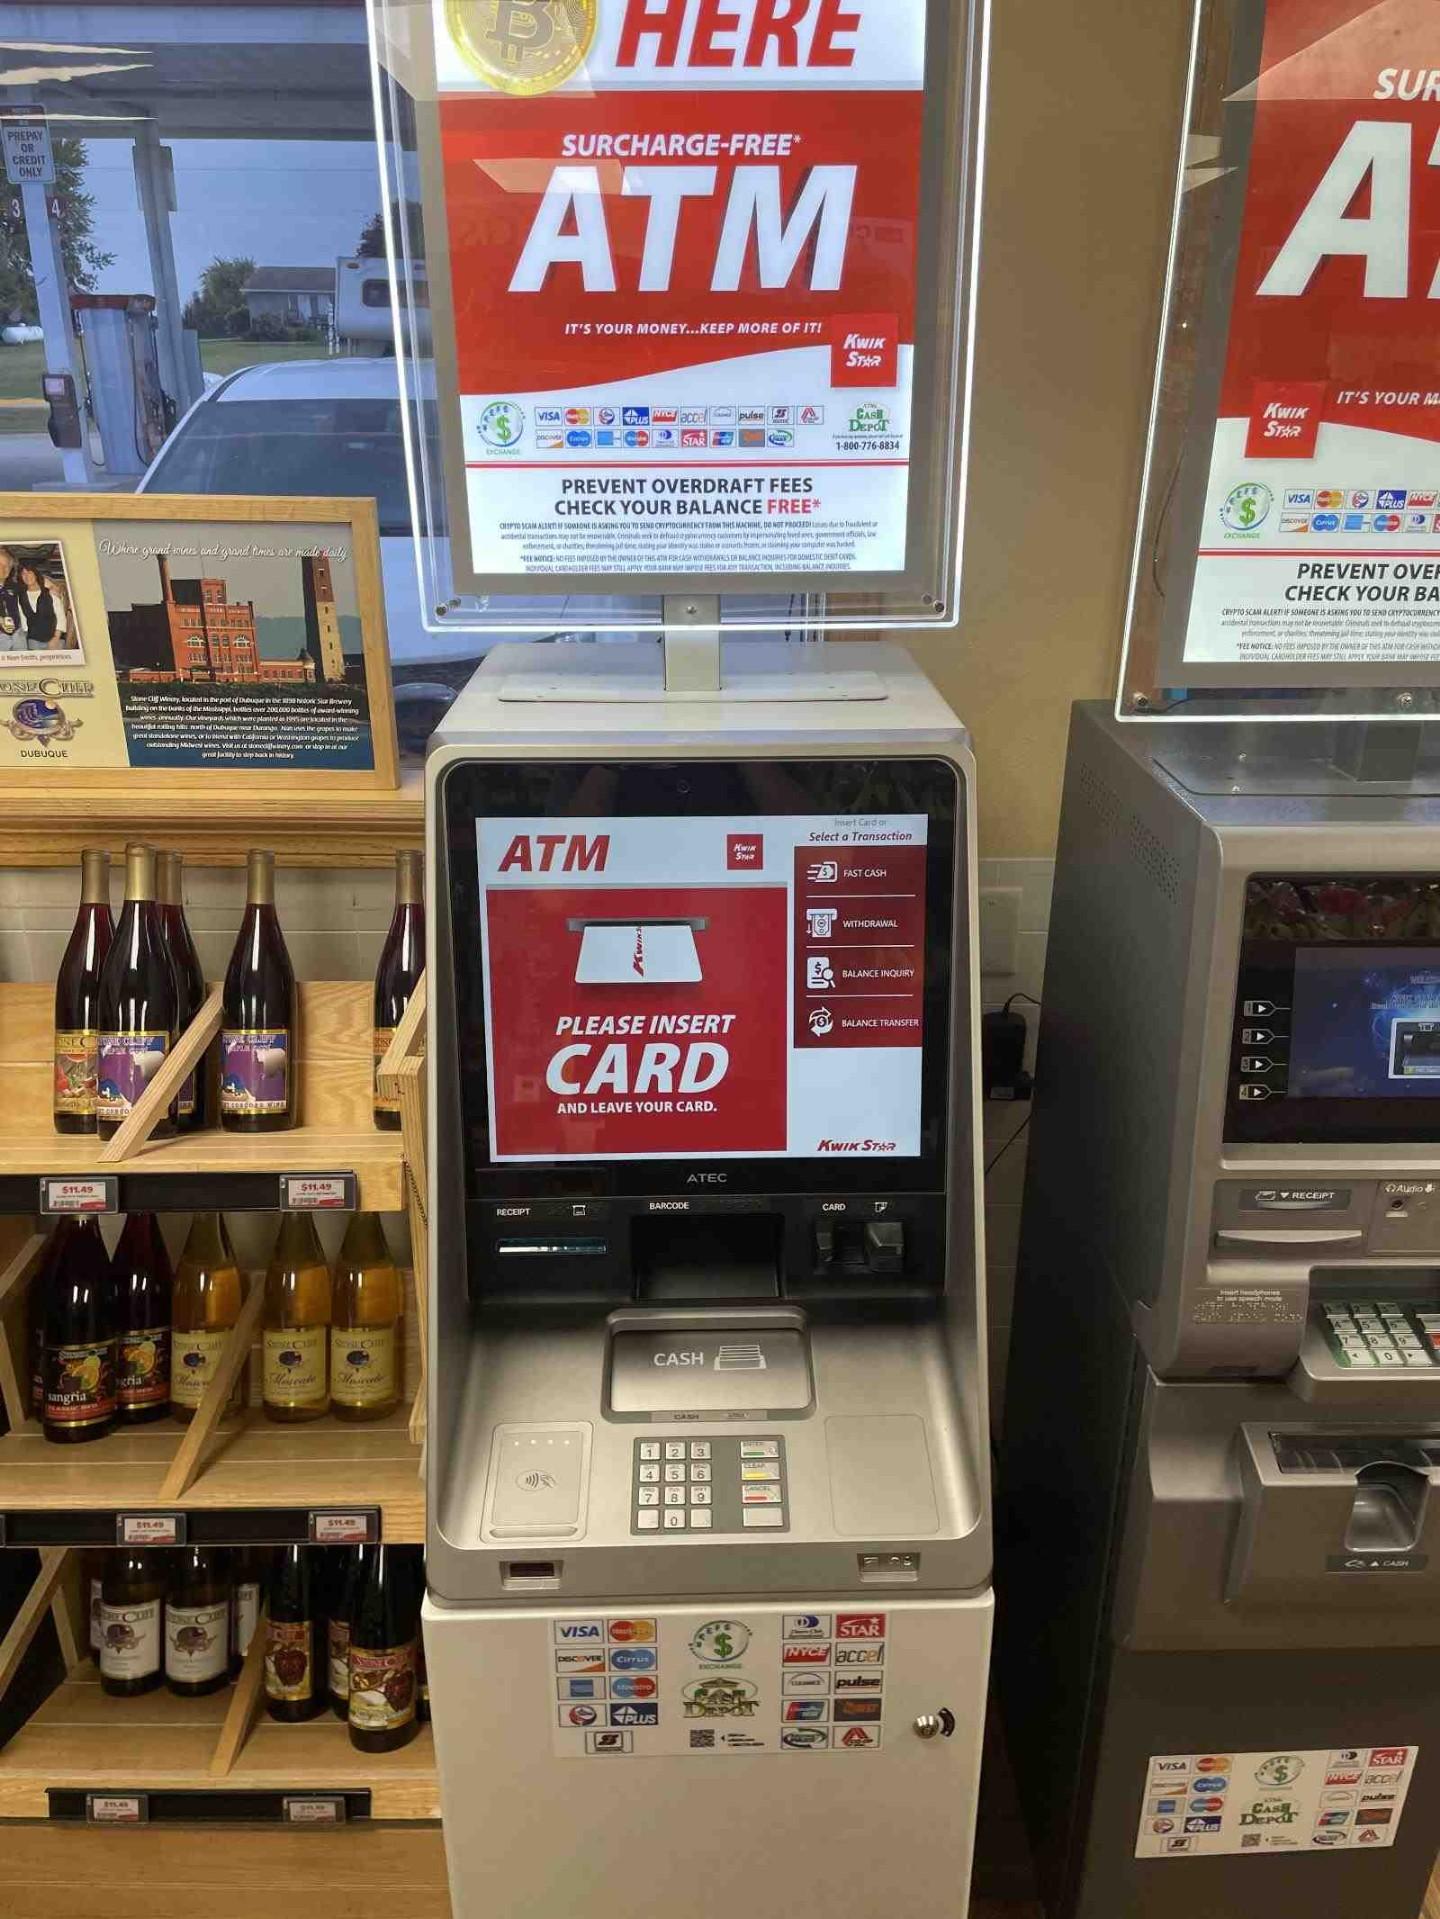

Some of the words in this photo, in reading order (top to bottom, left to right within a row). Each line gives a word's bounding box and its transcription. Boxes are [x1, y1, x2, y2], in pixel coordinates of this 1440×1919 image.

[616, 0, 862, 68] HERE
[7, 130, 43, 141] PREPAY
[21, 143, 34, 153] OR
[12, 155, 46, 166] CREDIT
[19, 167, 42, 178] ONLY
[11, 199, 20, 218] 3
[51, 198, 61, 219] 4
[507, 165, 858, 293] ATM
[595, 323, 635, 336] YOUR
[738, 322, 780, 335] MORE
[782, 322, 801, 335] OF
[803, 322, 822, 335] IT!
[1374, 391, 1424, 406] YOUR
[538, 410, 560, 421] VISA
[739, 411, 764, 421] pulse
[629, 417, 649, 426] PLUS
[683, 435, 706, 447] STAR
[836, 440, 900, 451] 1-800-776-8834
[561, 479, 647, 494] PREVENT
[651, 478, 766, 494] OVERDRAFT
[769, 477, 813, 493] FEES
[1287, 494, 1311, 504] VISA
[1383, 500, 1406, 509] PLUS
[554, 500, 615, 515] CHECK
[620, 500, 672, 515] YOUR
[676, 499, 763, 515] BALANCE
[619, 522, 631, 530] YOU
[295, 545, 320, 558] made
[322, 546, 348, 562] daily
[1297, 563, 1390, 580] PREVENT
[1285, 585, 1351, 602] CHECK
[1355, 585, 1410, 602] YOUR
[1222, 608, 1245, 616] CRYPTO
[1290, 608, 1319, 616] SOMEONE
[1327, 608, 1349, 616] ASKING
[20, 750, 69, 758] DUBUQUE
[834, 818, 857, 827] Insert
[858, 818, 877, 827] Card
[808, 831, 839, 842] Select
[841, 834, 849, 842] a
[851, 831, 913, 841] Transaction
[497, 834, 611, 872] ATM
[843, 869, 864, 878] FAST
[864, 869, 887, 878] CASH
[842, 919, 899, 929] WITHDRAWAL
[842, 968, 879, 979] BALANCE
[880, 967, 915, 979] INQUIRY
[555, 1015, 646, 1036] PLEASE
[648, 1014, 737, 1034] INSERT
[841, 1018, 878, 1029] BALANCE
[879, 1017, 920, 1028] TRANSFER
[545, 1042, 730, 1096] CARD
[557, 1101, 588, 1115] AND
[591, 1101, 633, 1114] LEAVE
[635, 1101, 675, 1113] YOUR
[676, 1100, 718, 1112] CARD.
[686, 1173, 728, 1184] ATEC
[61, 1185, 94, 1195] $11.49
[301, 1183, 332, 1193] $11.49
[1396, 1184, 1424, 1193] Audio
[1291, 1191, 1336, 1199] RECEIPT
[649, 1201, 690, 1211] BARCODE
[822, 1202, 846, 1211] CARD
[496, 1207, 531, 1217] RECEIPT
[653, 1351, 705, 1368] CASH
[673, 1413, 700, 1421] CASH
[646, 1448, 653, 1458] 1
[671, 1448, 679, 1458] 2
[697, 1448, 705, 1458] 3
[645, 1470, 653, 1480] 4
[671, 1470, 679, 1480] 5
[697, 1469, 705, 1479] 6
[645, 1493, 653, 1503] 7
[671, 1492, 679, 1503] 8
[696, 1492, 705, 1502] 9
[670, 1516, 678, 1527] 0
[561, 1626, 600, 1638] VISA
[840, 1624, 880, 1637] STAR
[788, 1647, 829, 1657] NYCE
[836, 1643, 885, 1664] accel
[616, 1655, 650, 1664] Cirrus
[836, 1675, 881, 1689] pulse
[625, 1713, 656, 1725] PLUS
[1159, 1762, 1187, 1771] VISA
